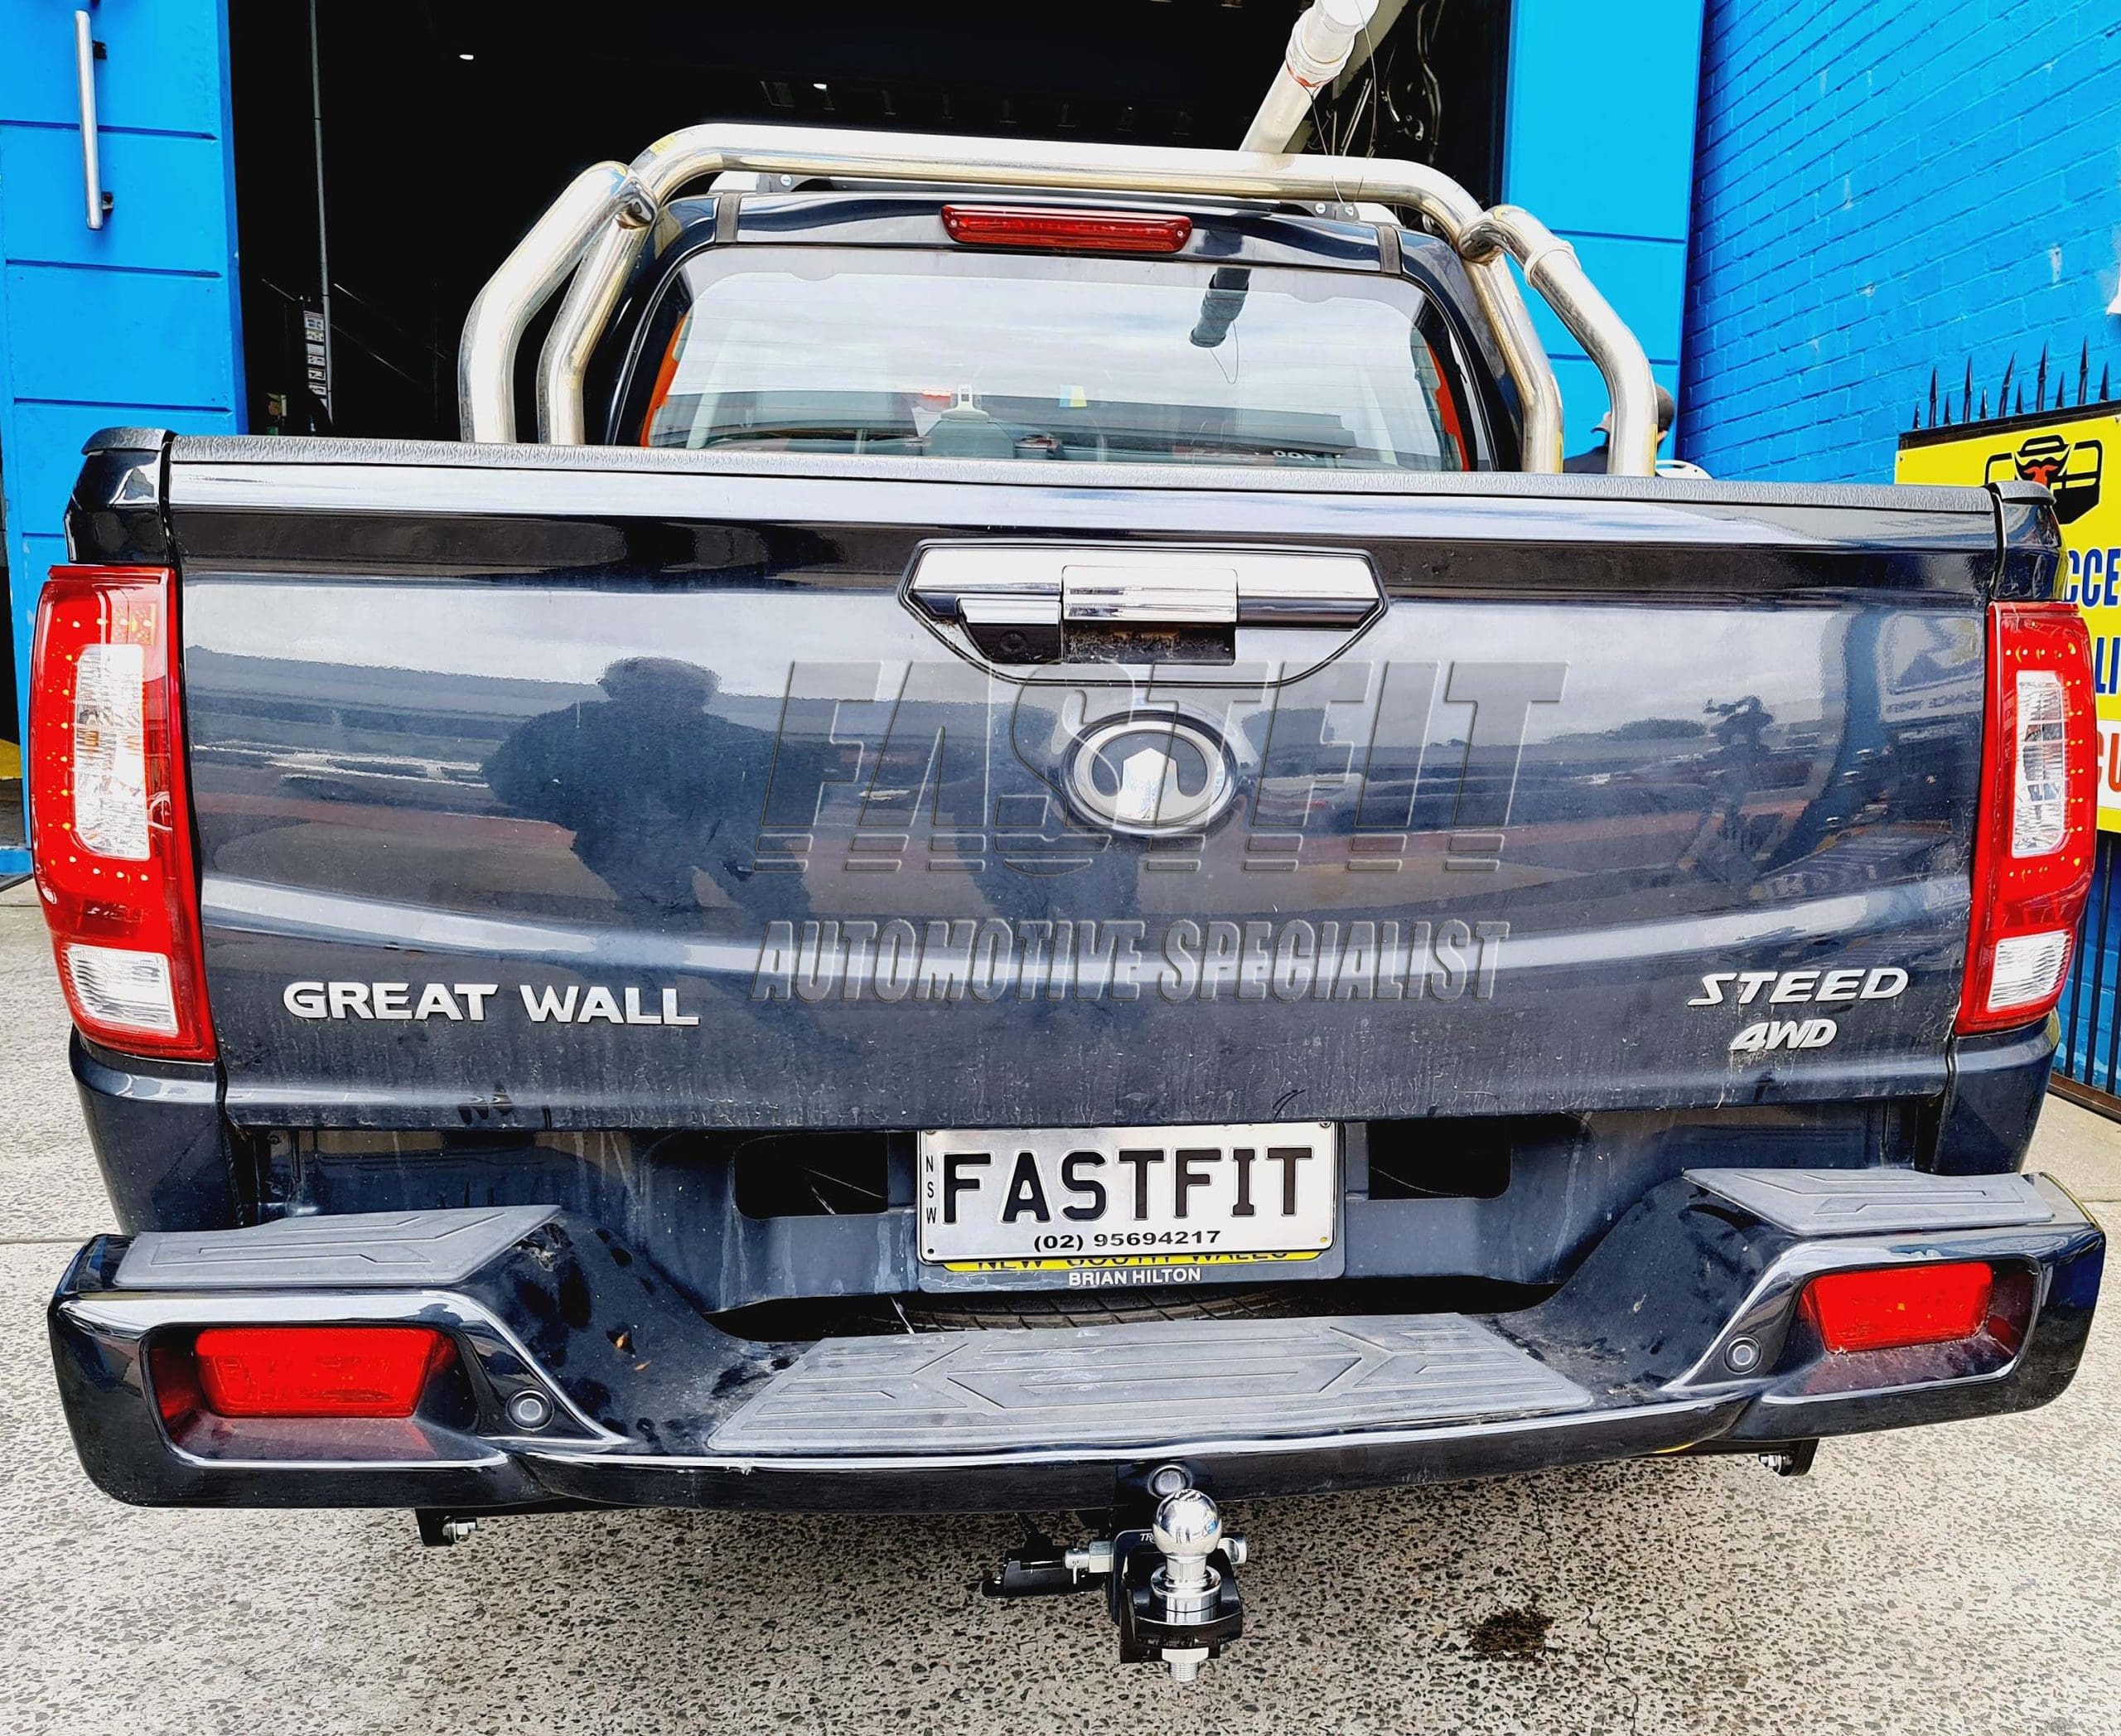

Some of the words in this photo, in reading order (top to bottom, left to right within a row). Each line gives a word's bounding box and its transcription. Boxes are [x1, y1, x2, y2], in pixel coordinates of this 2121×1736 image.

[283, 981, 498, 1021] GREAT
[519, 984, 699, 1026] WALL
[1687, 968, 1909, 1006] STEED
[1728, 1018, 1838, 1052] 4WD
[942, 1147, 1314, 1224] FASTFIT
[1034, 1235, 1084, 1252] (02)
[1094, 1231, 1221, 1247] 95694217
[1069, 1270, 1128, 1286] BRIAN
[1132, 1267, 1201, 1284] HILTON
